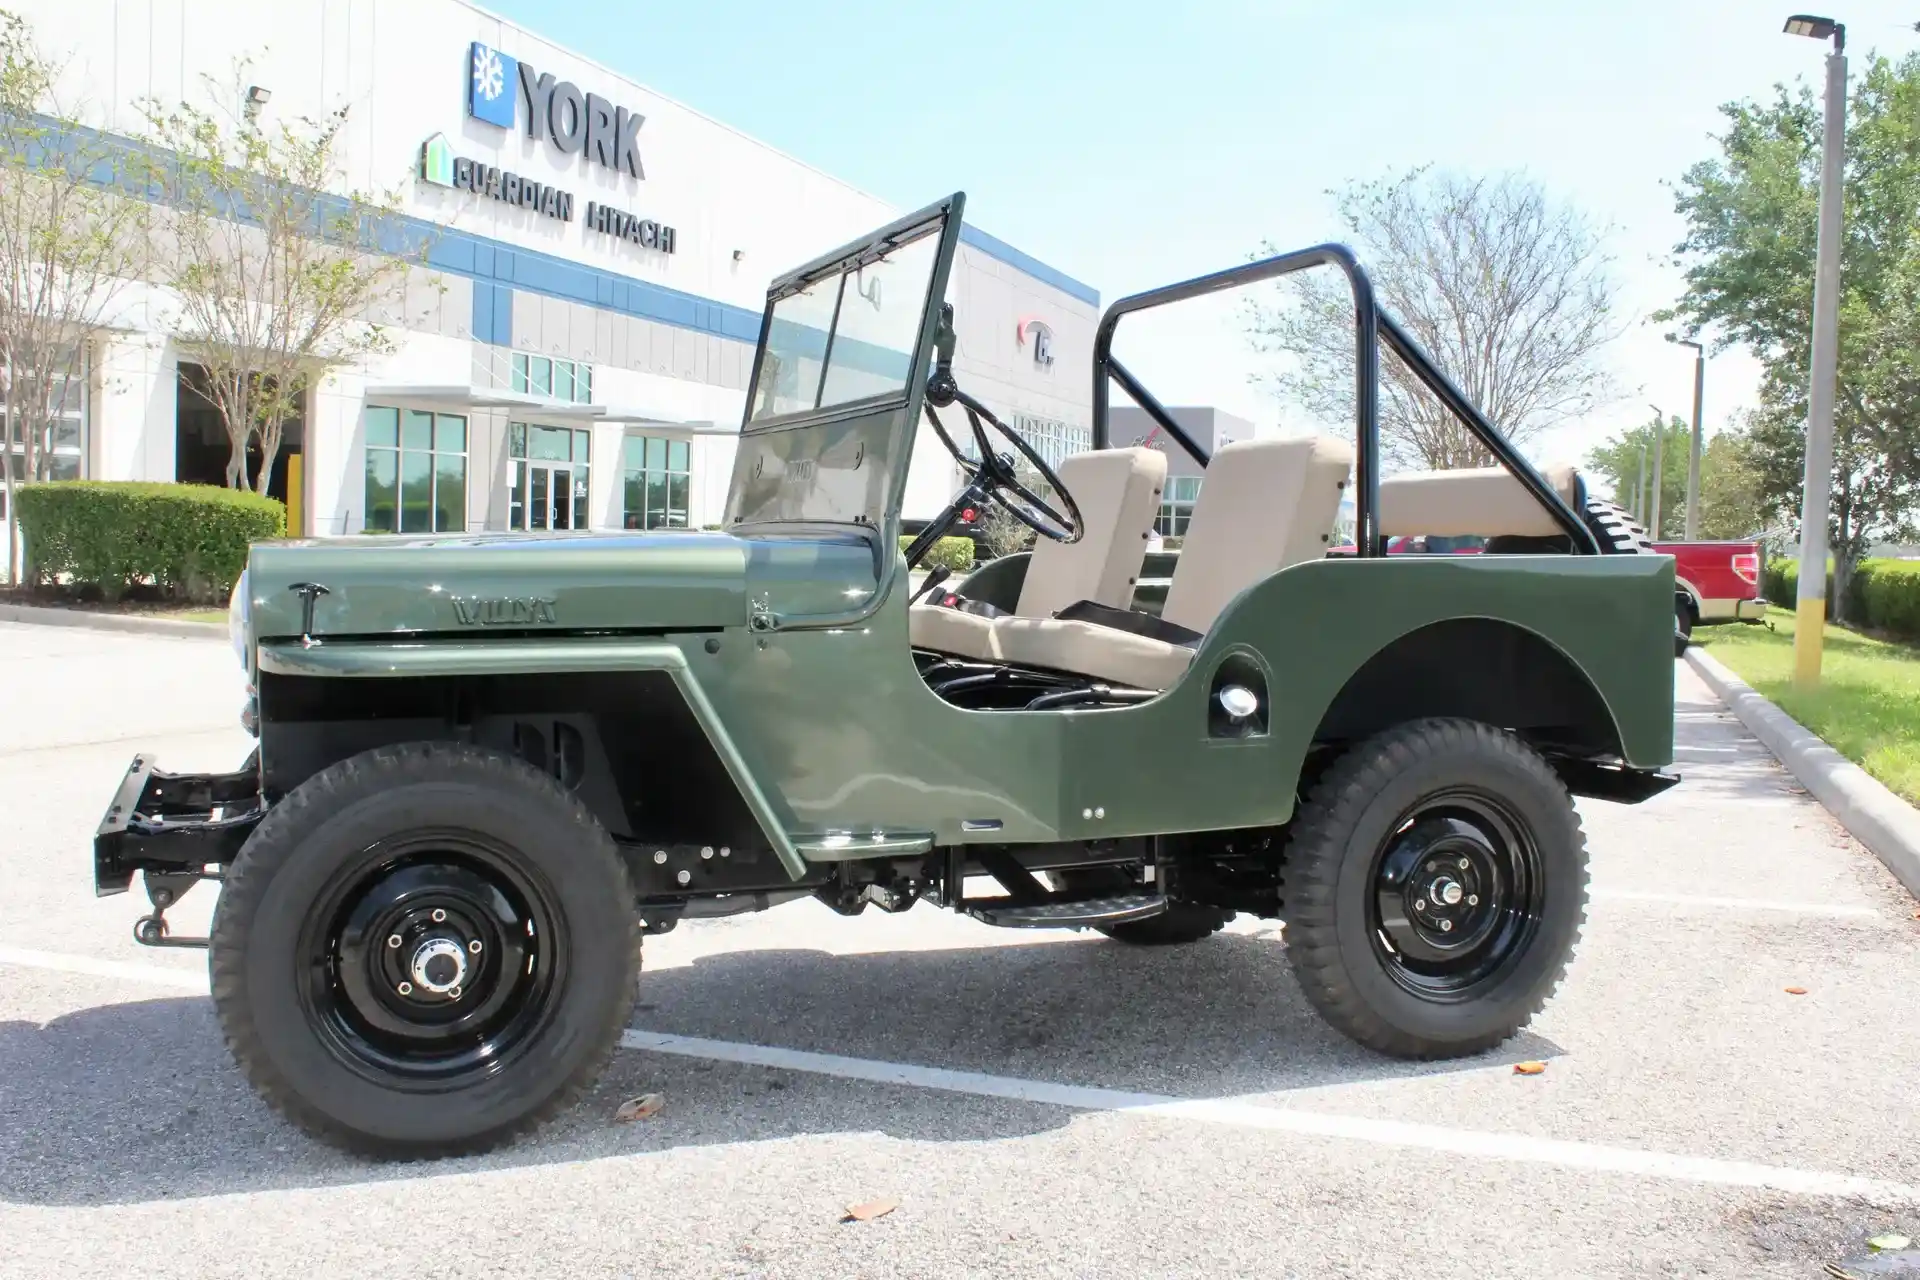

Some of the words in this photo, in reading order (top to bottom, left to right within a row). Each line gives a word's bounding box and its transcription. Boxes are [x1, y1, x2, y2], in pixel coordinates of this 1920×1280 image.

[517, 61, 645, 180] YORK
[453, 156, 574, 222] GUARDIAN
[587, 201, 676, 254] HITACHI
